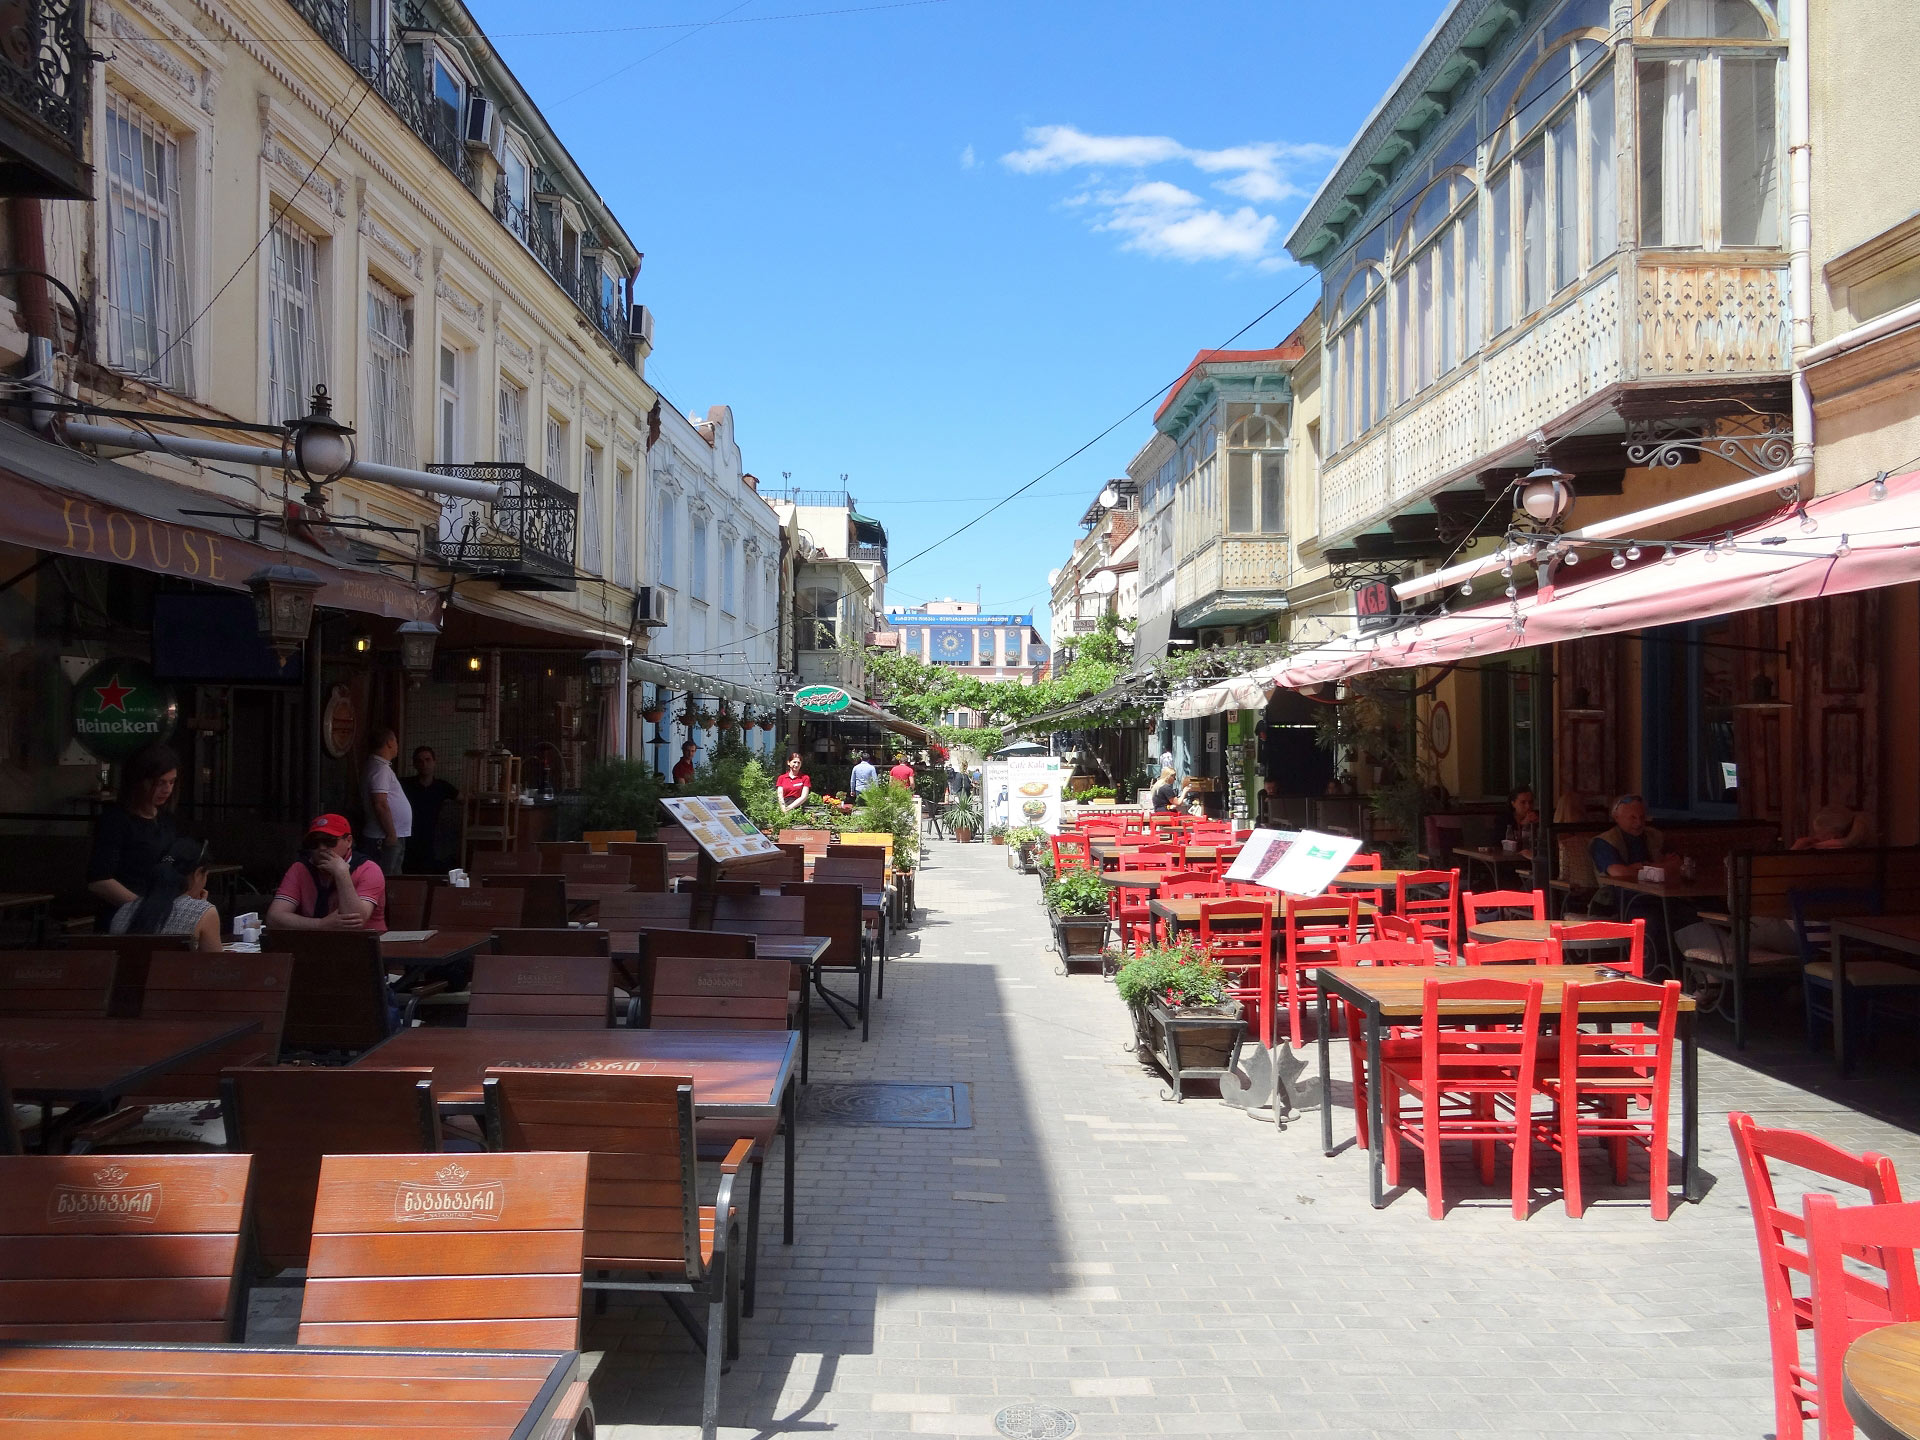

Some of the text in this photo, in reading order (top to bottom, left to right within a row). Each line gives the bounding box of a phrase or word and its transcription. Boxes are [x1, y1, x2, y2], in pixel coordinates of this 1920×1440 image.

[63, 498, 226, 581] HOUSE
[1356, 583, 1388, 616] KGB
[76, 718, 160, 734] Heineken
[58, 1192, 153, 1213] ნატახტარი
[404, 1190, 494, 1212] ნატახტარი
